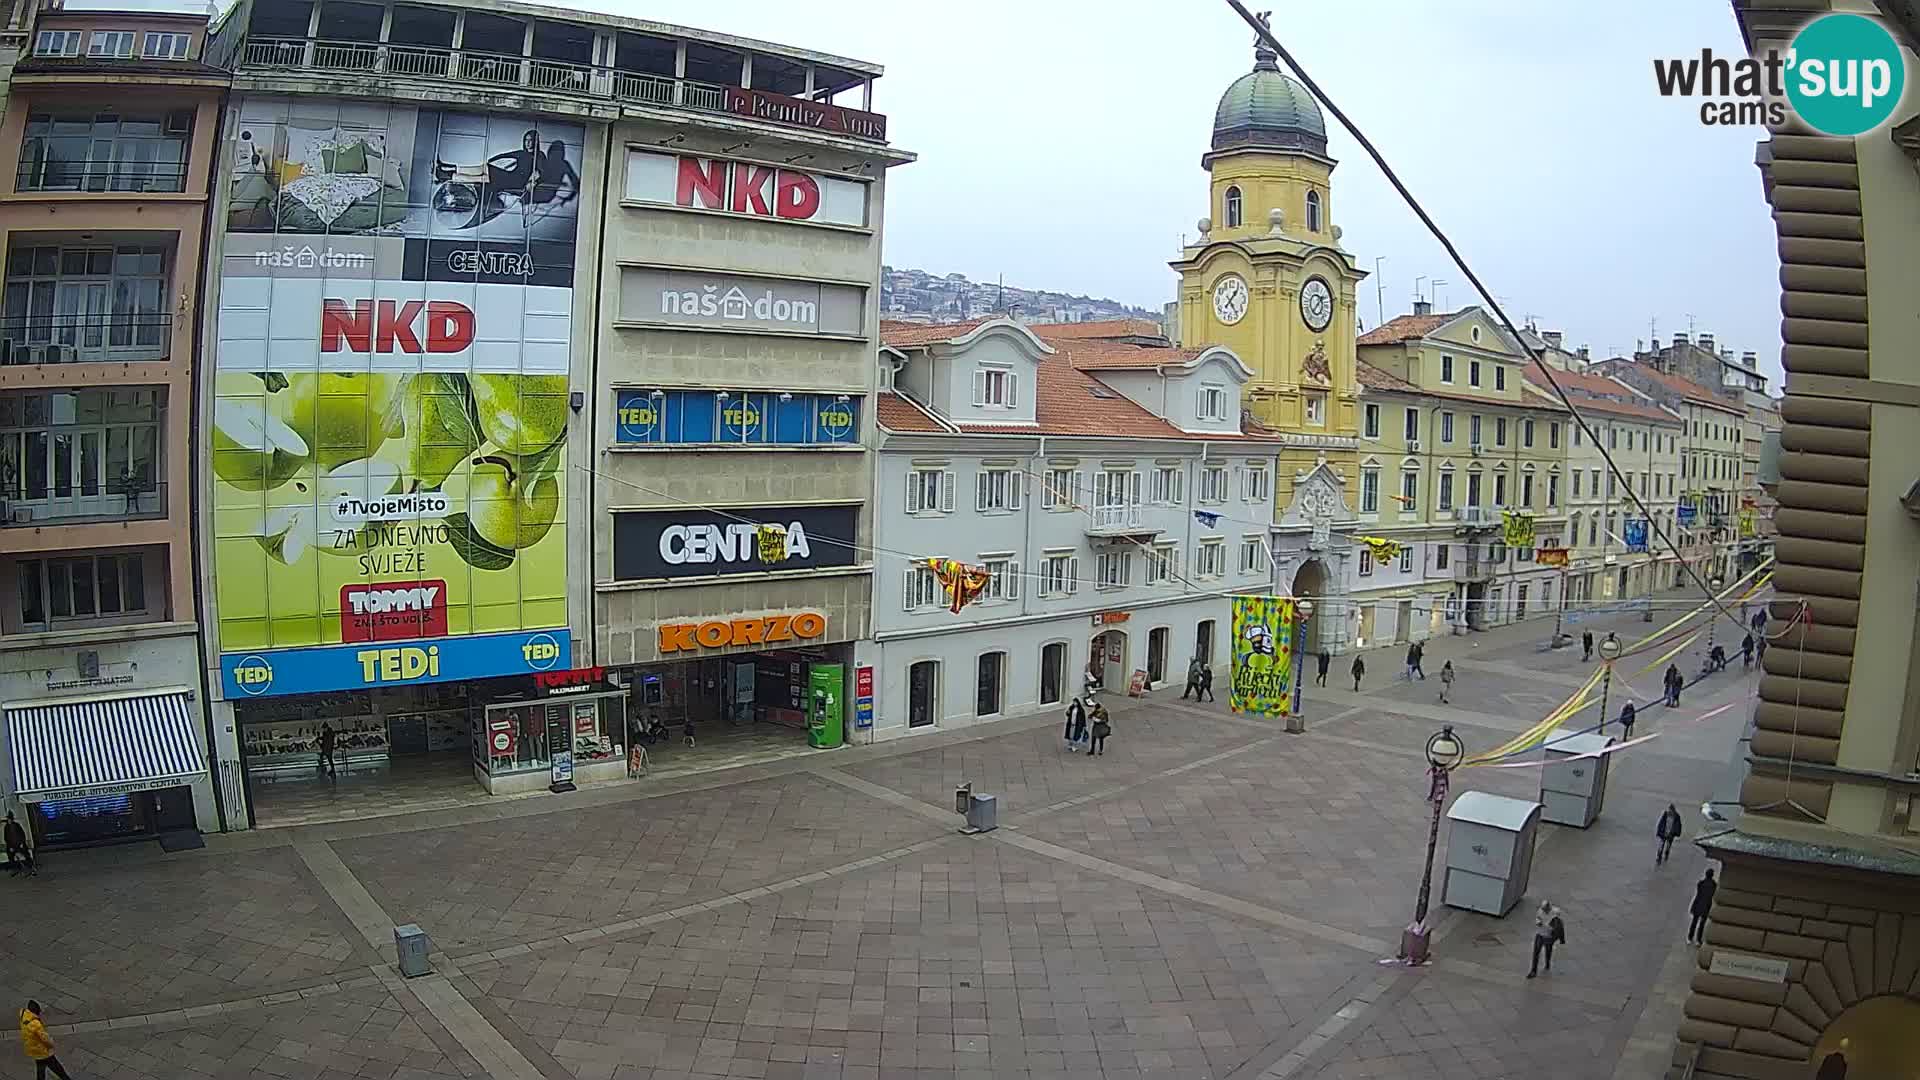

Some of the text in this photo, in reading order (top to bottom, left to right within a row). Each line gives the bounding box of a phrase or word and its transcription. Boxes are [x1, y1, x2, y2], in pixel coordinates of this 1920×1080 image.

[723, 89, 746, 112] Le
[675, 157, 821, 221] NKD
[255, 243, 366, 270] naš dom
[447, 249, 536, 277] CENTRA
[661, 283, 817, 324] naš dom
[320, 297, 477, 355] NKD
[618, 408, 658, 426] TEDi
[723, 409, 760, 426] TEDi
[819, 411, 853, 427] TEDi
[338, 497, 446, 518] #TvojeMisto
[333, 523, 450, 549] ZA DNEVNO
[359, 550, 427, 576] SVJEŽE
[348, 586, 440, 615] TOMMY
[379, 614, 400, 626] ŠTO
[659, 612, 826, 653] KORZO
[357, 643, 440, 683] TEDi
[521, 641, 561, 661] TEDi
[233, 664, 273, 686] TEDi
